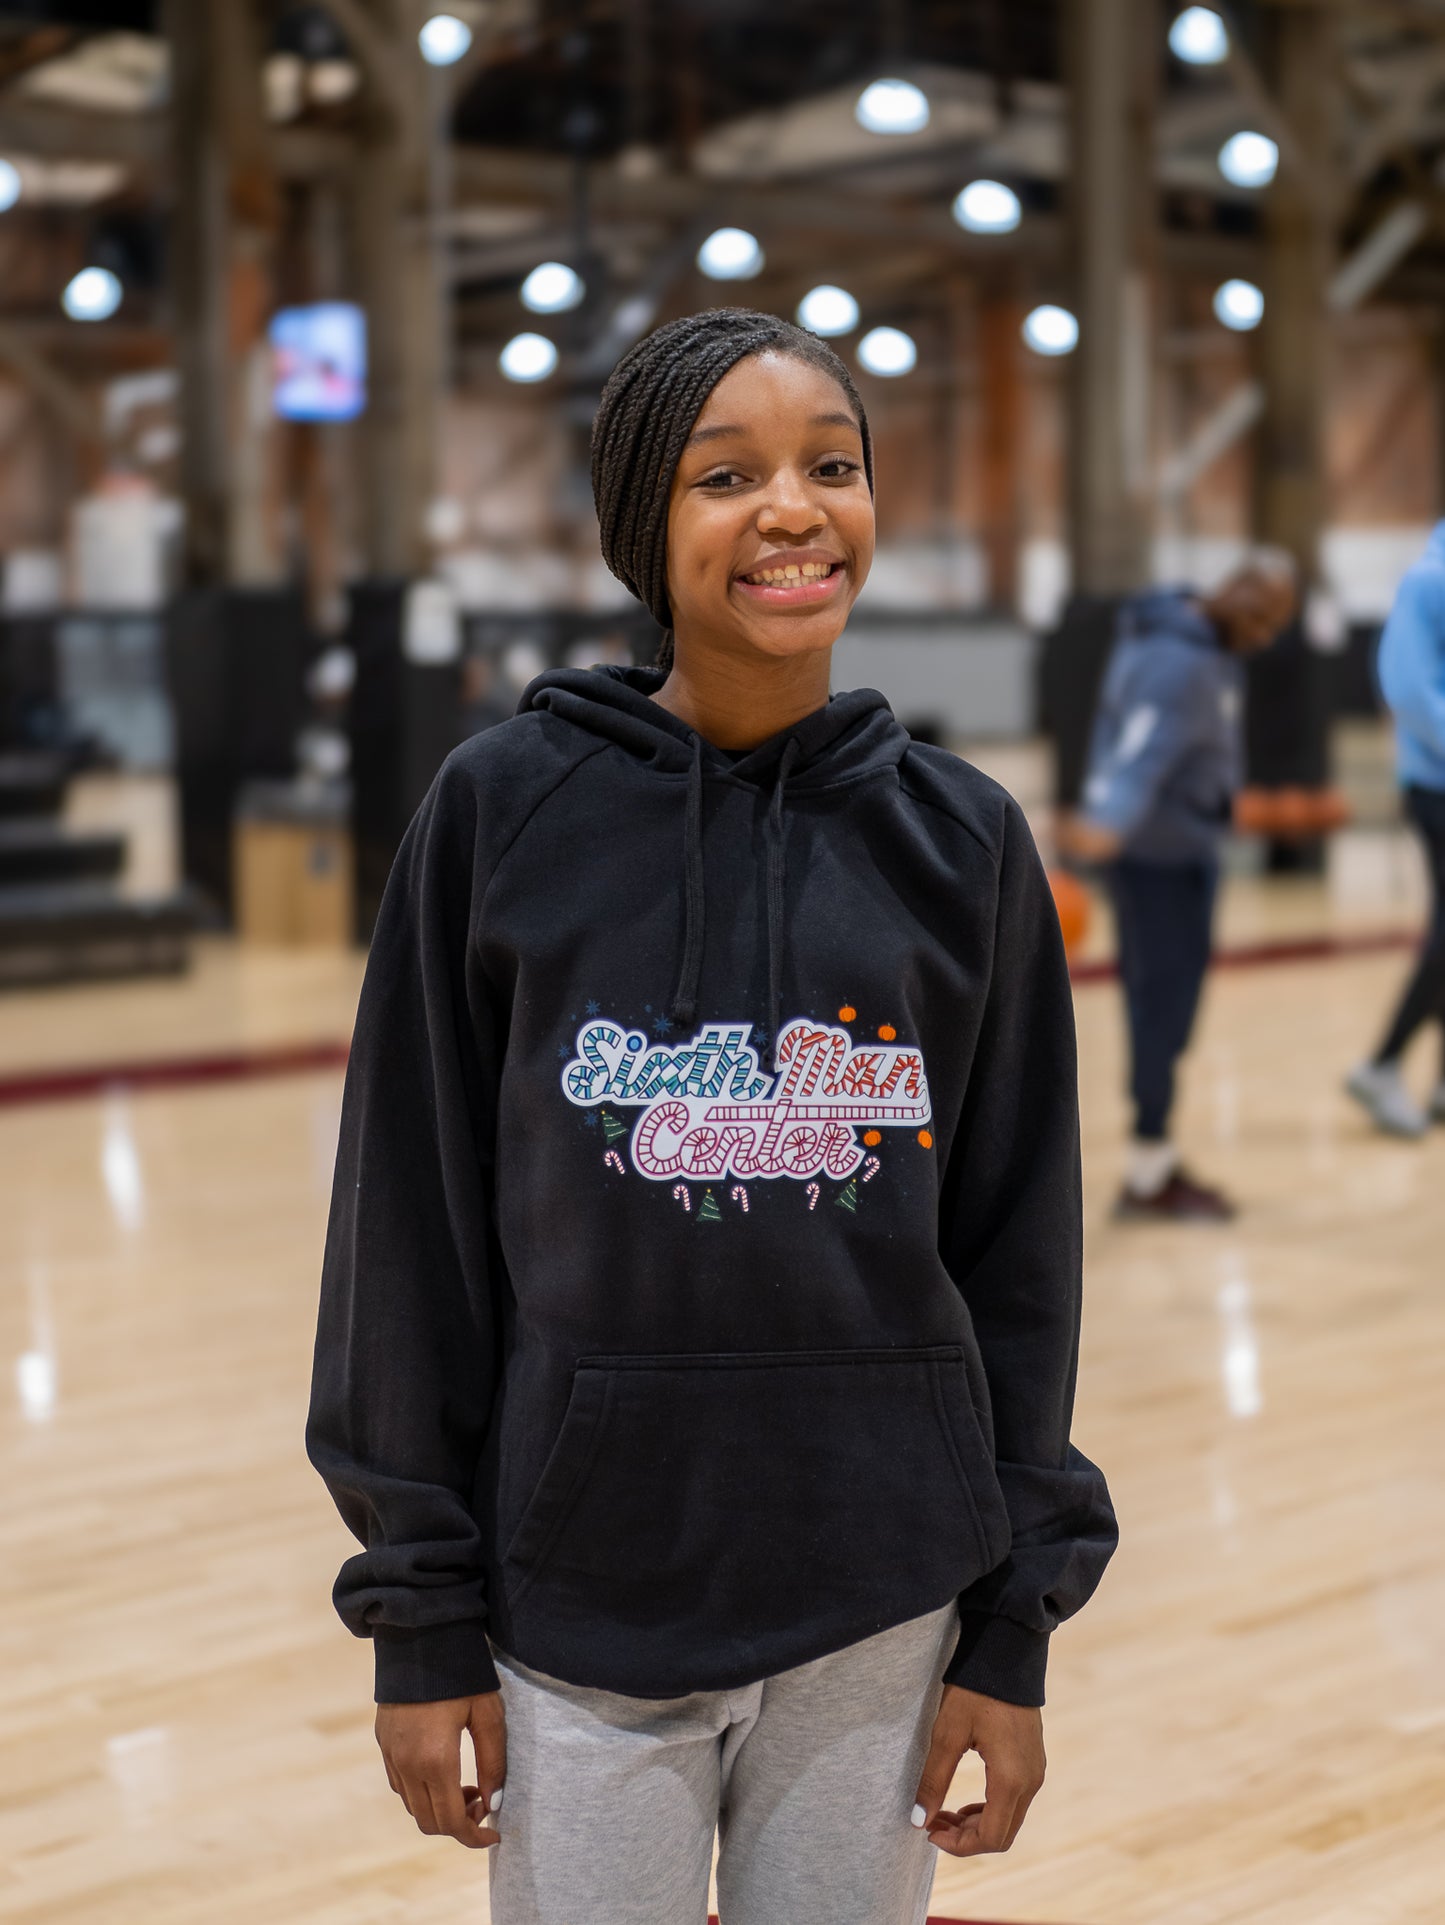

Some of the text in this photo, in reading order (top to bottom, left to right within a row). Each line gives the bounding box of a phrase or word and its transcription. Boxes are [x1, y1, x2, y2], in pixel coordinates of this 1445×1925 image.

[567, 1025, 927, 1102] Sixth Man
[637, 1099, 859, 1175] Center
